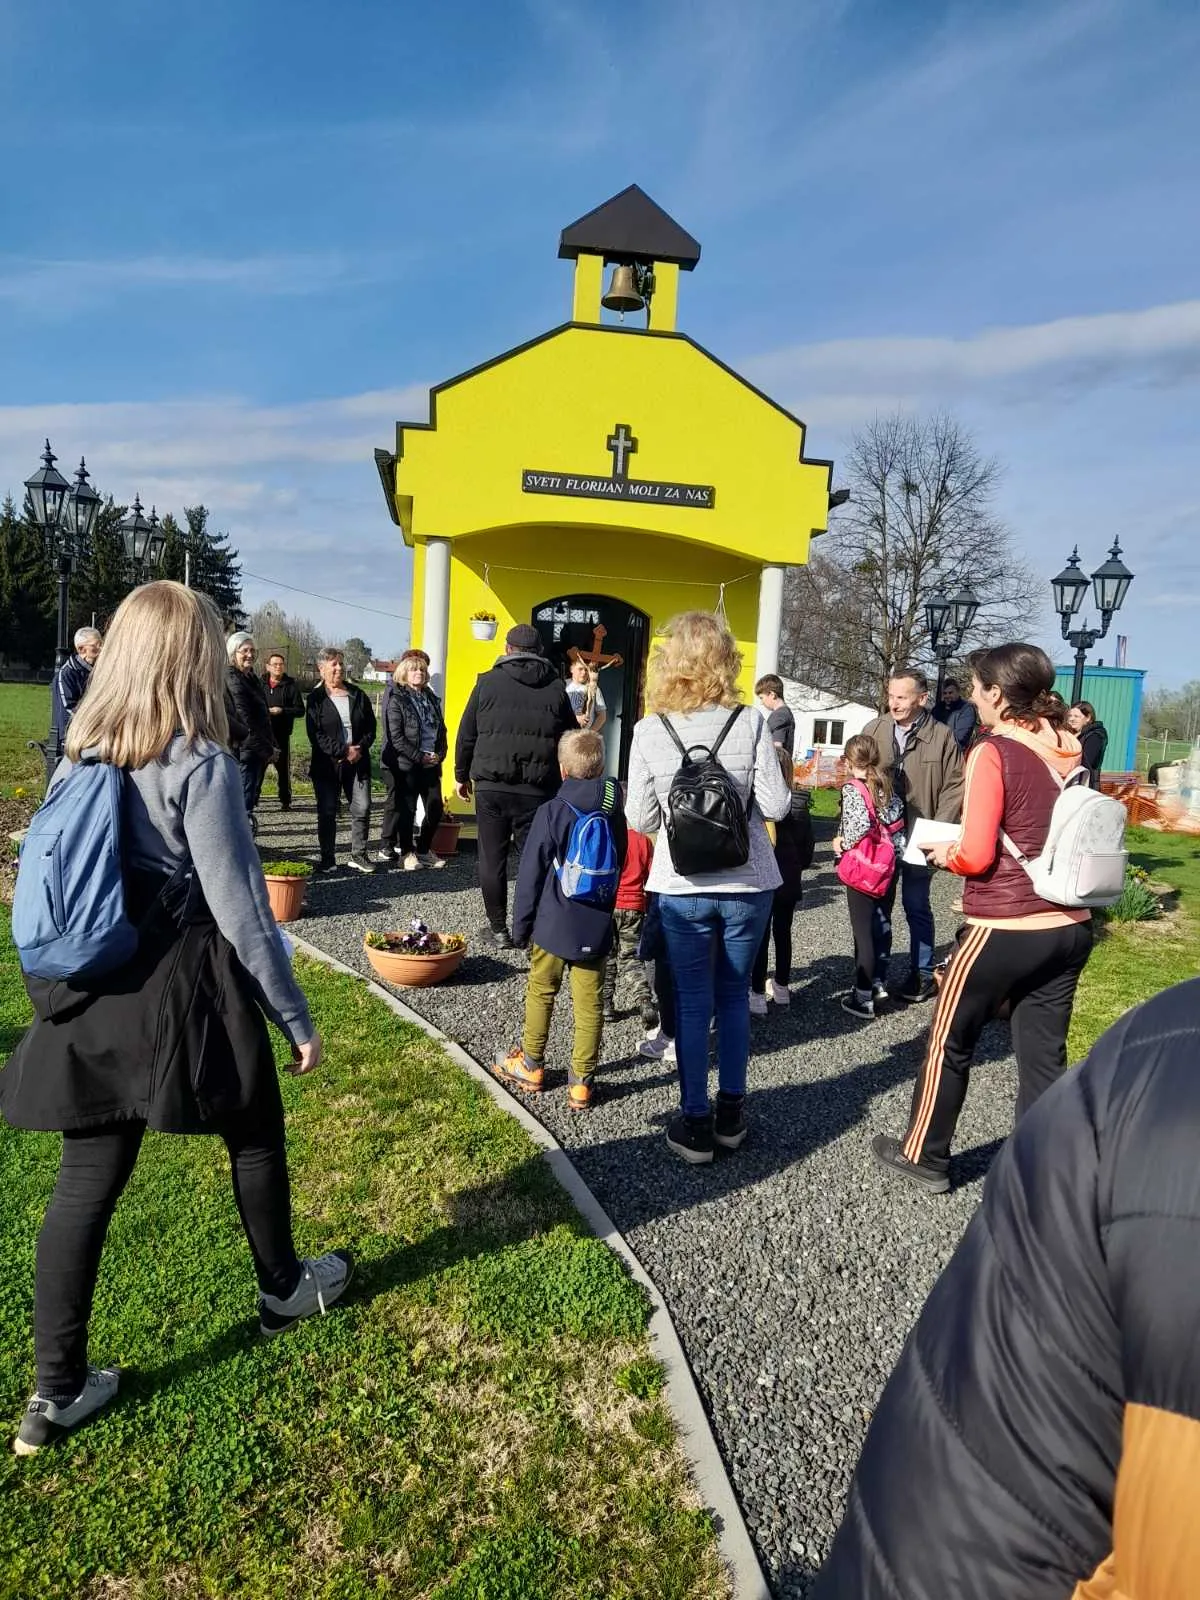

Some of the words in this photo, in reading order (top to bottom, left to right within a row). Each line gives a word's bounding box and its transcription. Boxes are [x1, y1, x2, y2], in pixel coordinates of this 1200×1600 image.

[526, 475, 561, 488] SVETI
[565, 479, 624, 493] FLORIJAN
[628, 484, 660, 497] MOLI
[664, 487, 680, 498] ZA
[685, 489, 710, 500] NAS
